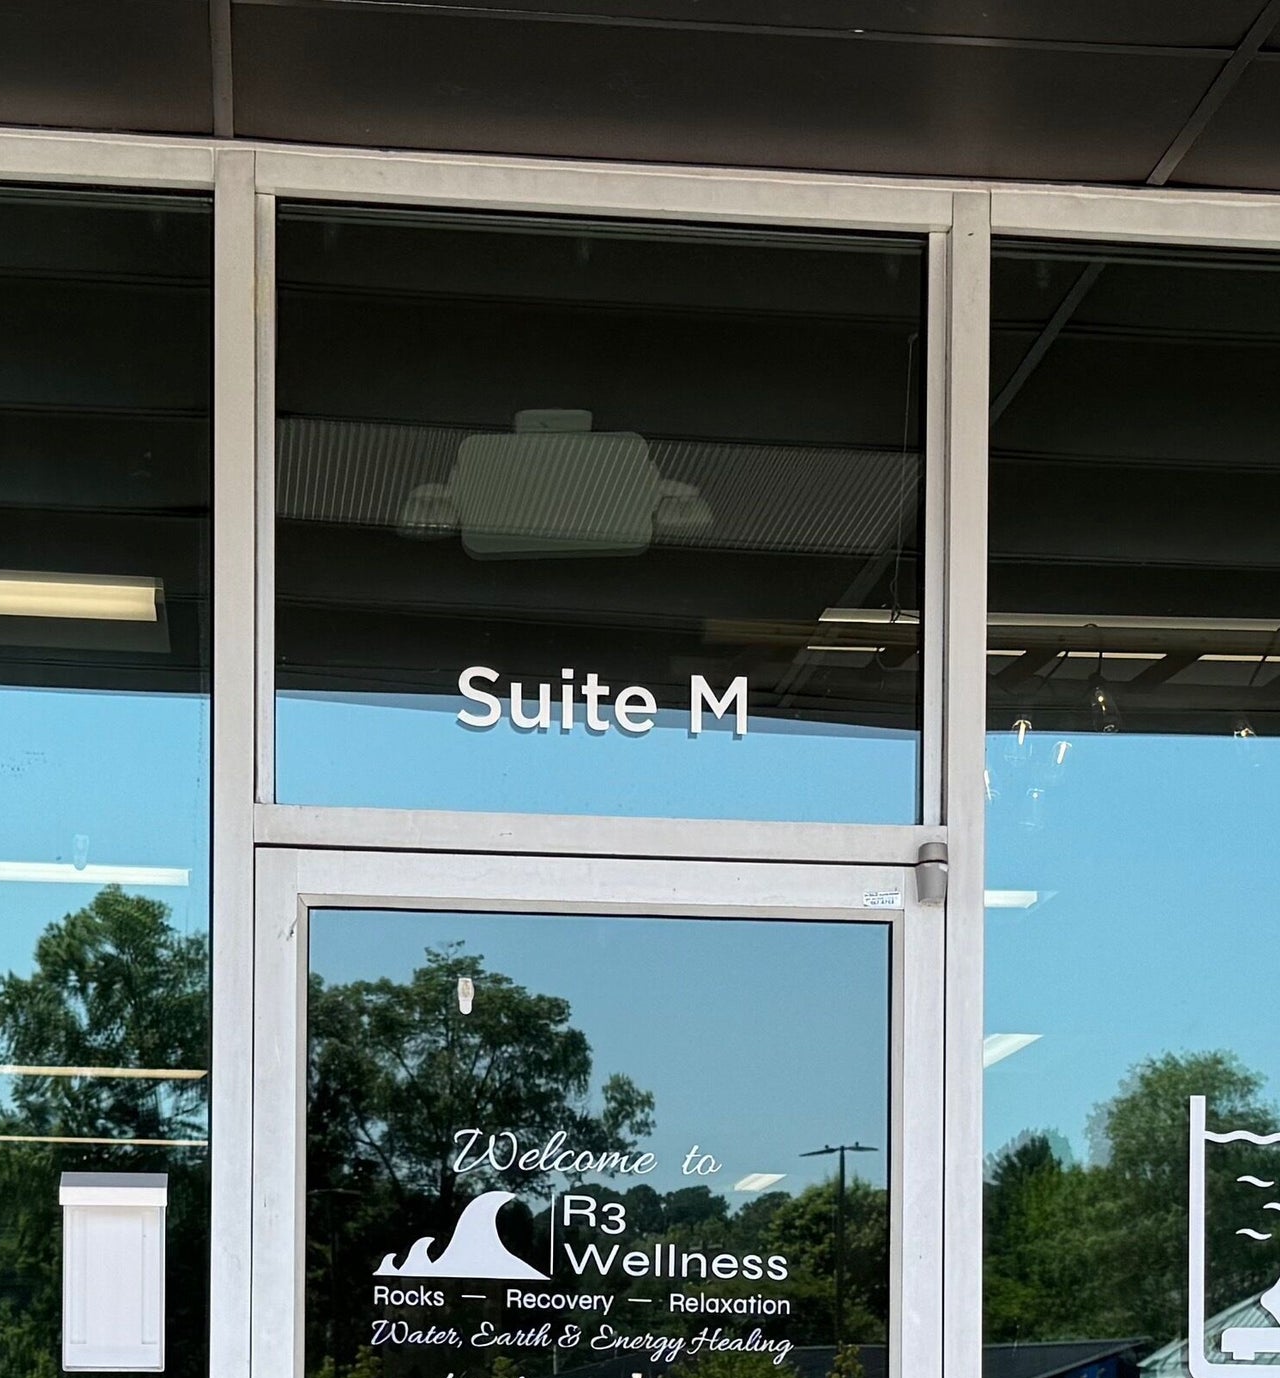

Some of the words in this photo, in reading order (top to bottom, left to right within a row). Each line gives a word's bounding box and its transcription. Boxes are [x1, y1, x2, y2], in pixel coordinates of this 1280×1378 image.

[458, 667, 657, 732] Suite
[692, 676, 748, 735] M
[452, 1127, 658, 1174] Welcome
[682, 1145, 722, 1175] to
[563, 1195, 627, 1234] R3
[564, 1243, 789, 1281] Wellness
[373, 1285, 445, 1307] Rocks
[506, 1289, 614, 1316] Recovery
[669, 1292, 791, 1316] Relaxation
[370, 1319, 463, 1348] Water,
[470, 1320, 552, 1347] Earth
[557, 1324, 582, 1348] &
[590, 1324, 685, 1362] Energy
[685, 1326, 793, 1365] Healing
